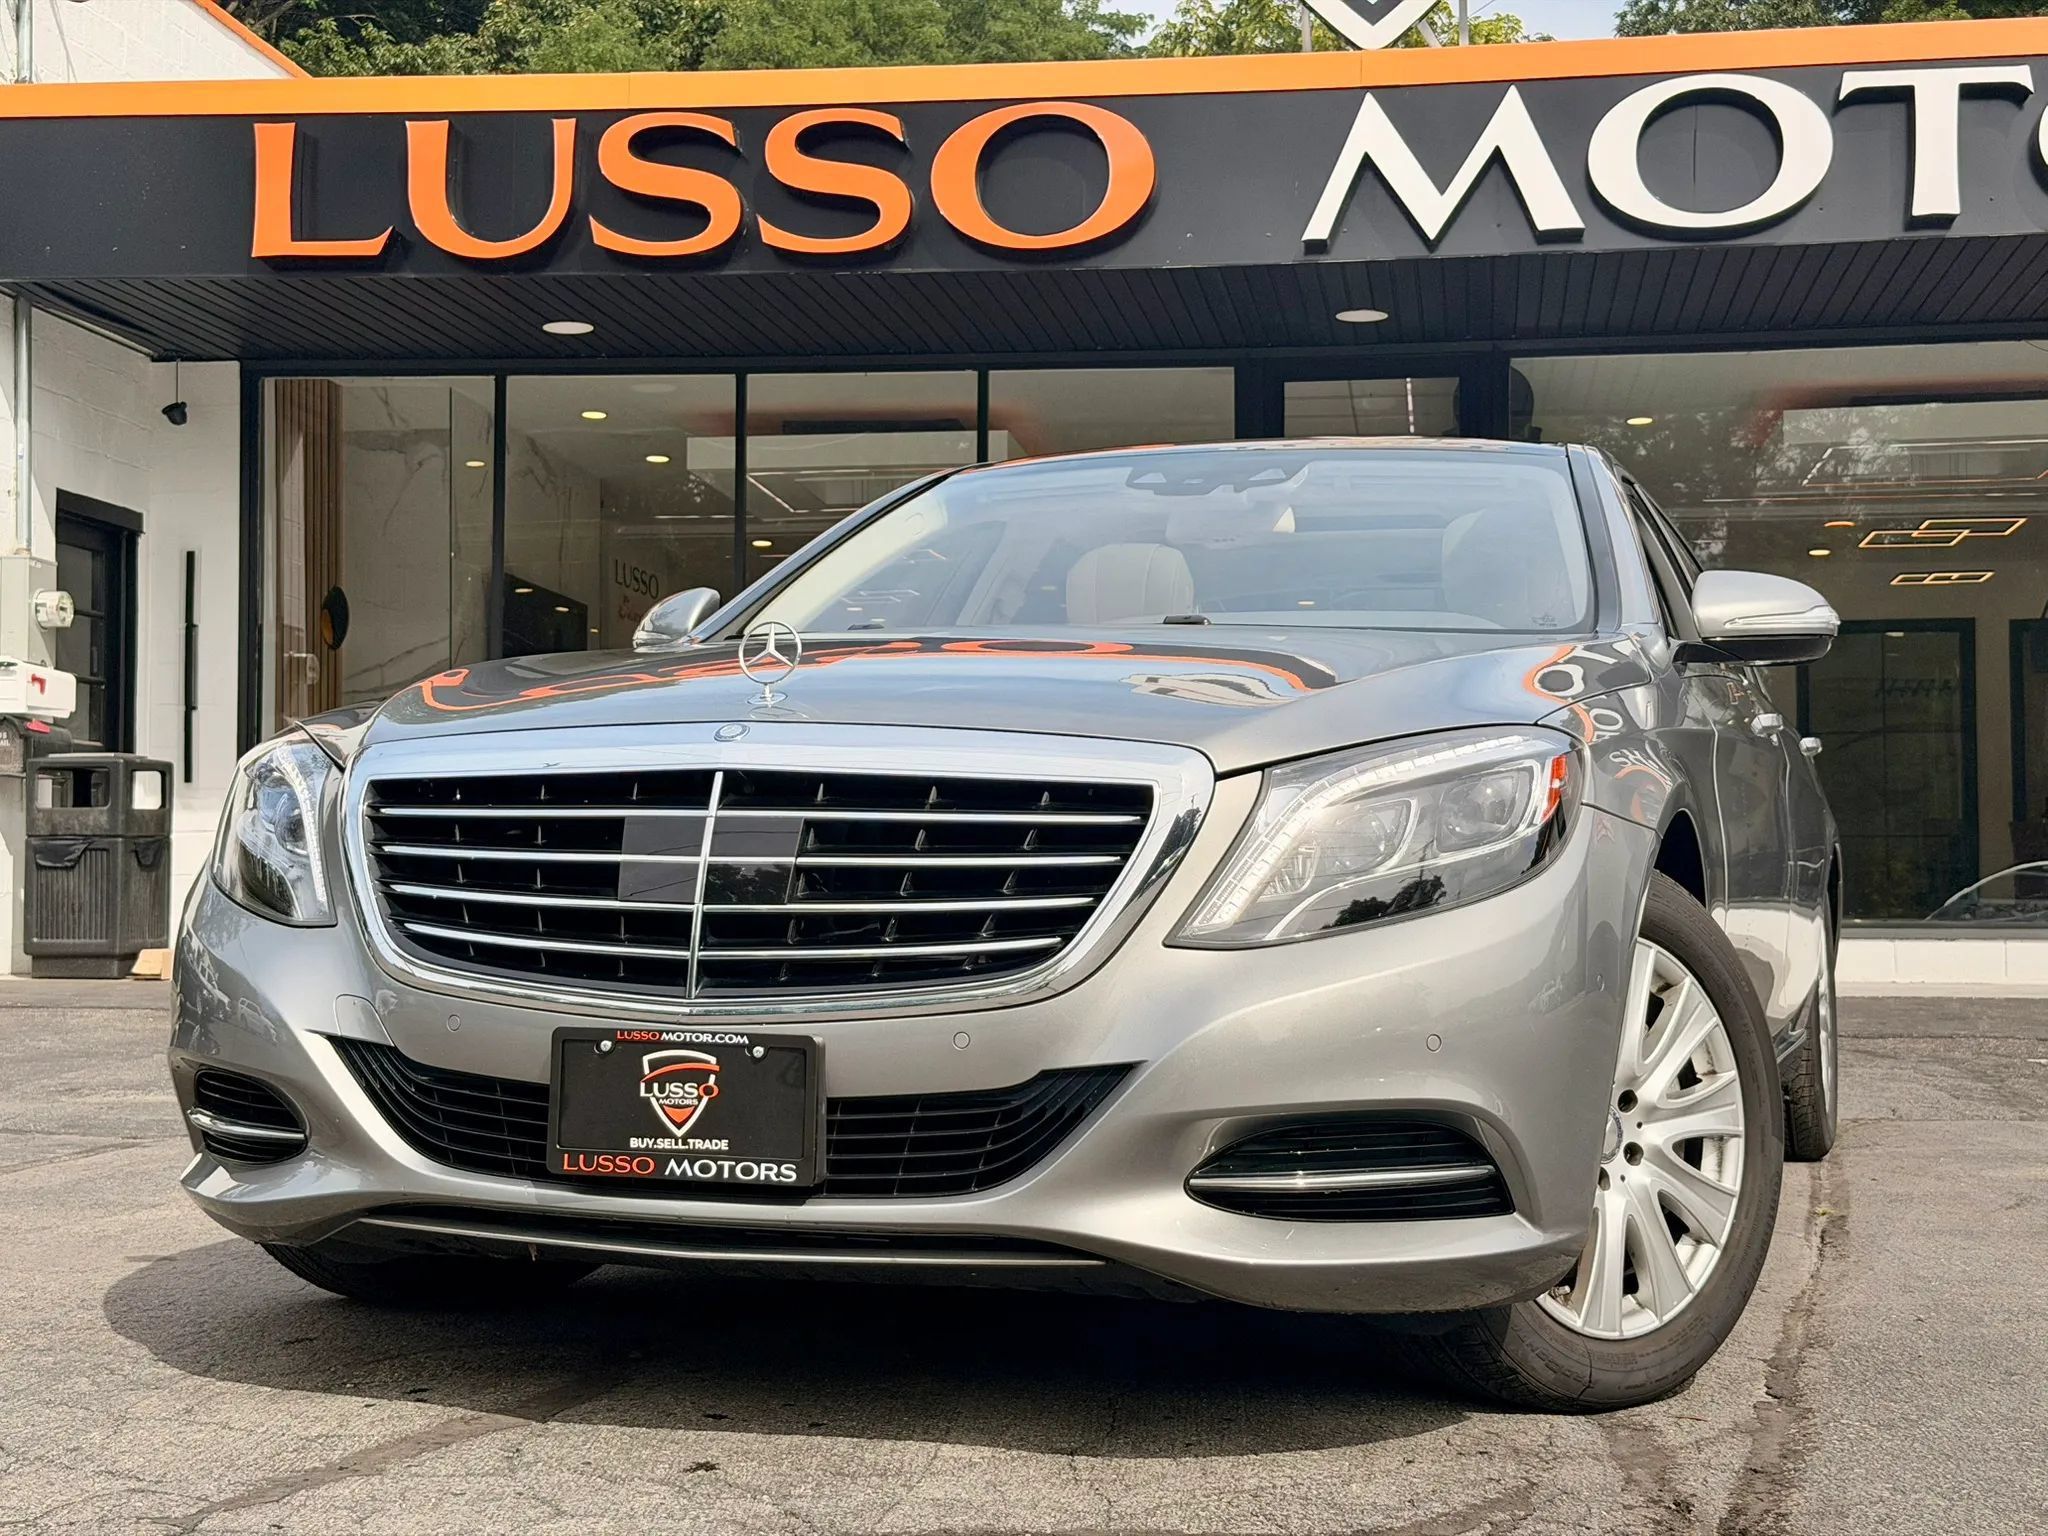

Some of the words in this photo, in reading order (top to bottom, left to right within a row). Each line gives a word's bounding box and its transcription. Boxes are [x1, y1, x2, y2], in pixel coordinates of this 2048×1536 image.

[251, 101, 1156, 260] LUSSO
[1301, 64, 2048, 246] MOT
[615, 559, 660, 599] LUSSO
[639, 1081, 719, 1099] LUSSO
[658, 1098, 699, 1106] MOTORS
[562, 1151, 656, 1175] LUSSO
[664, 1157, 798, 1183] MOTORS
